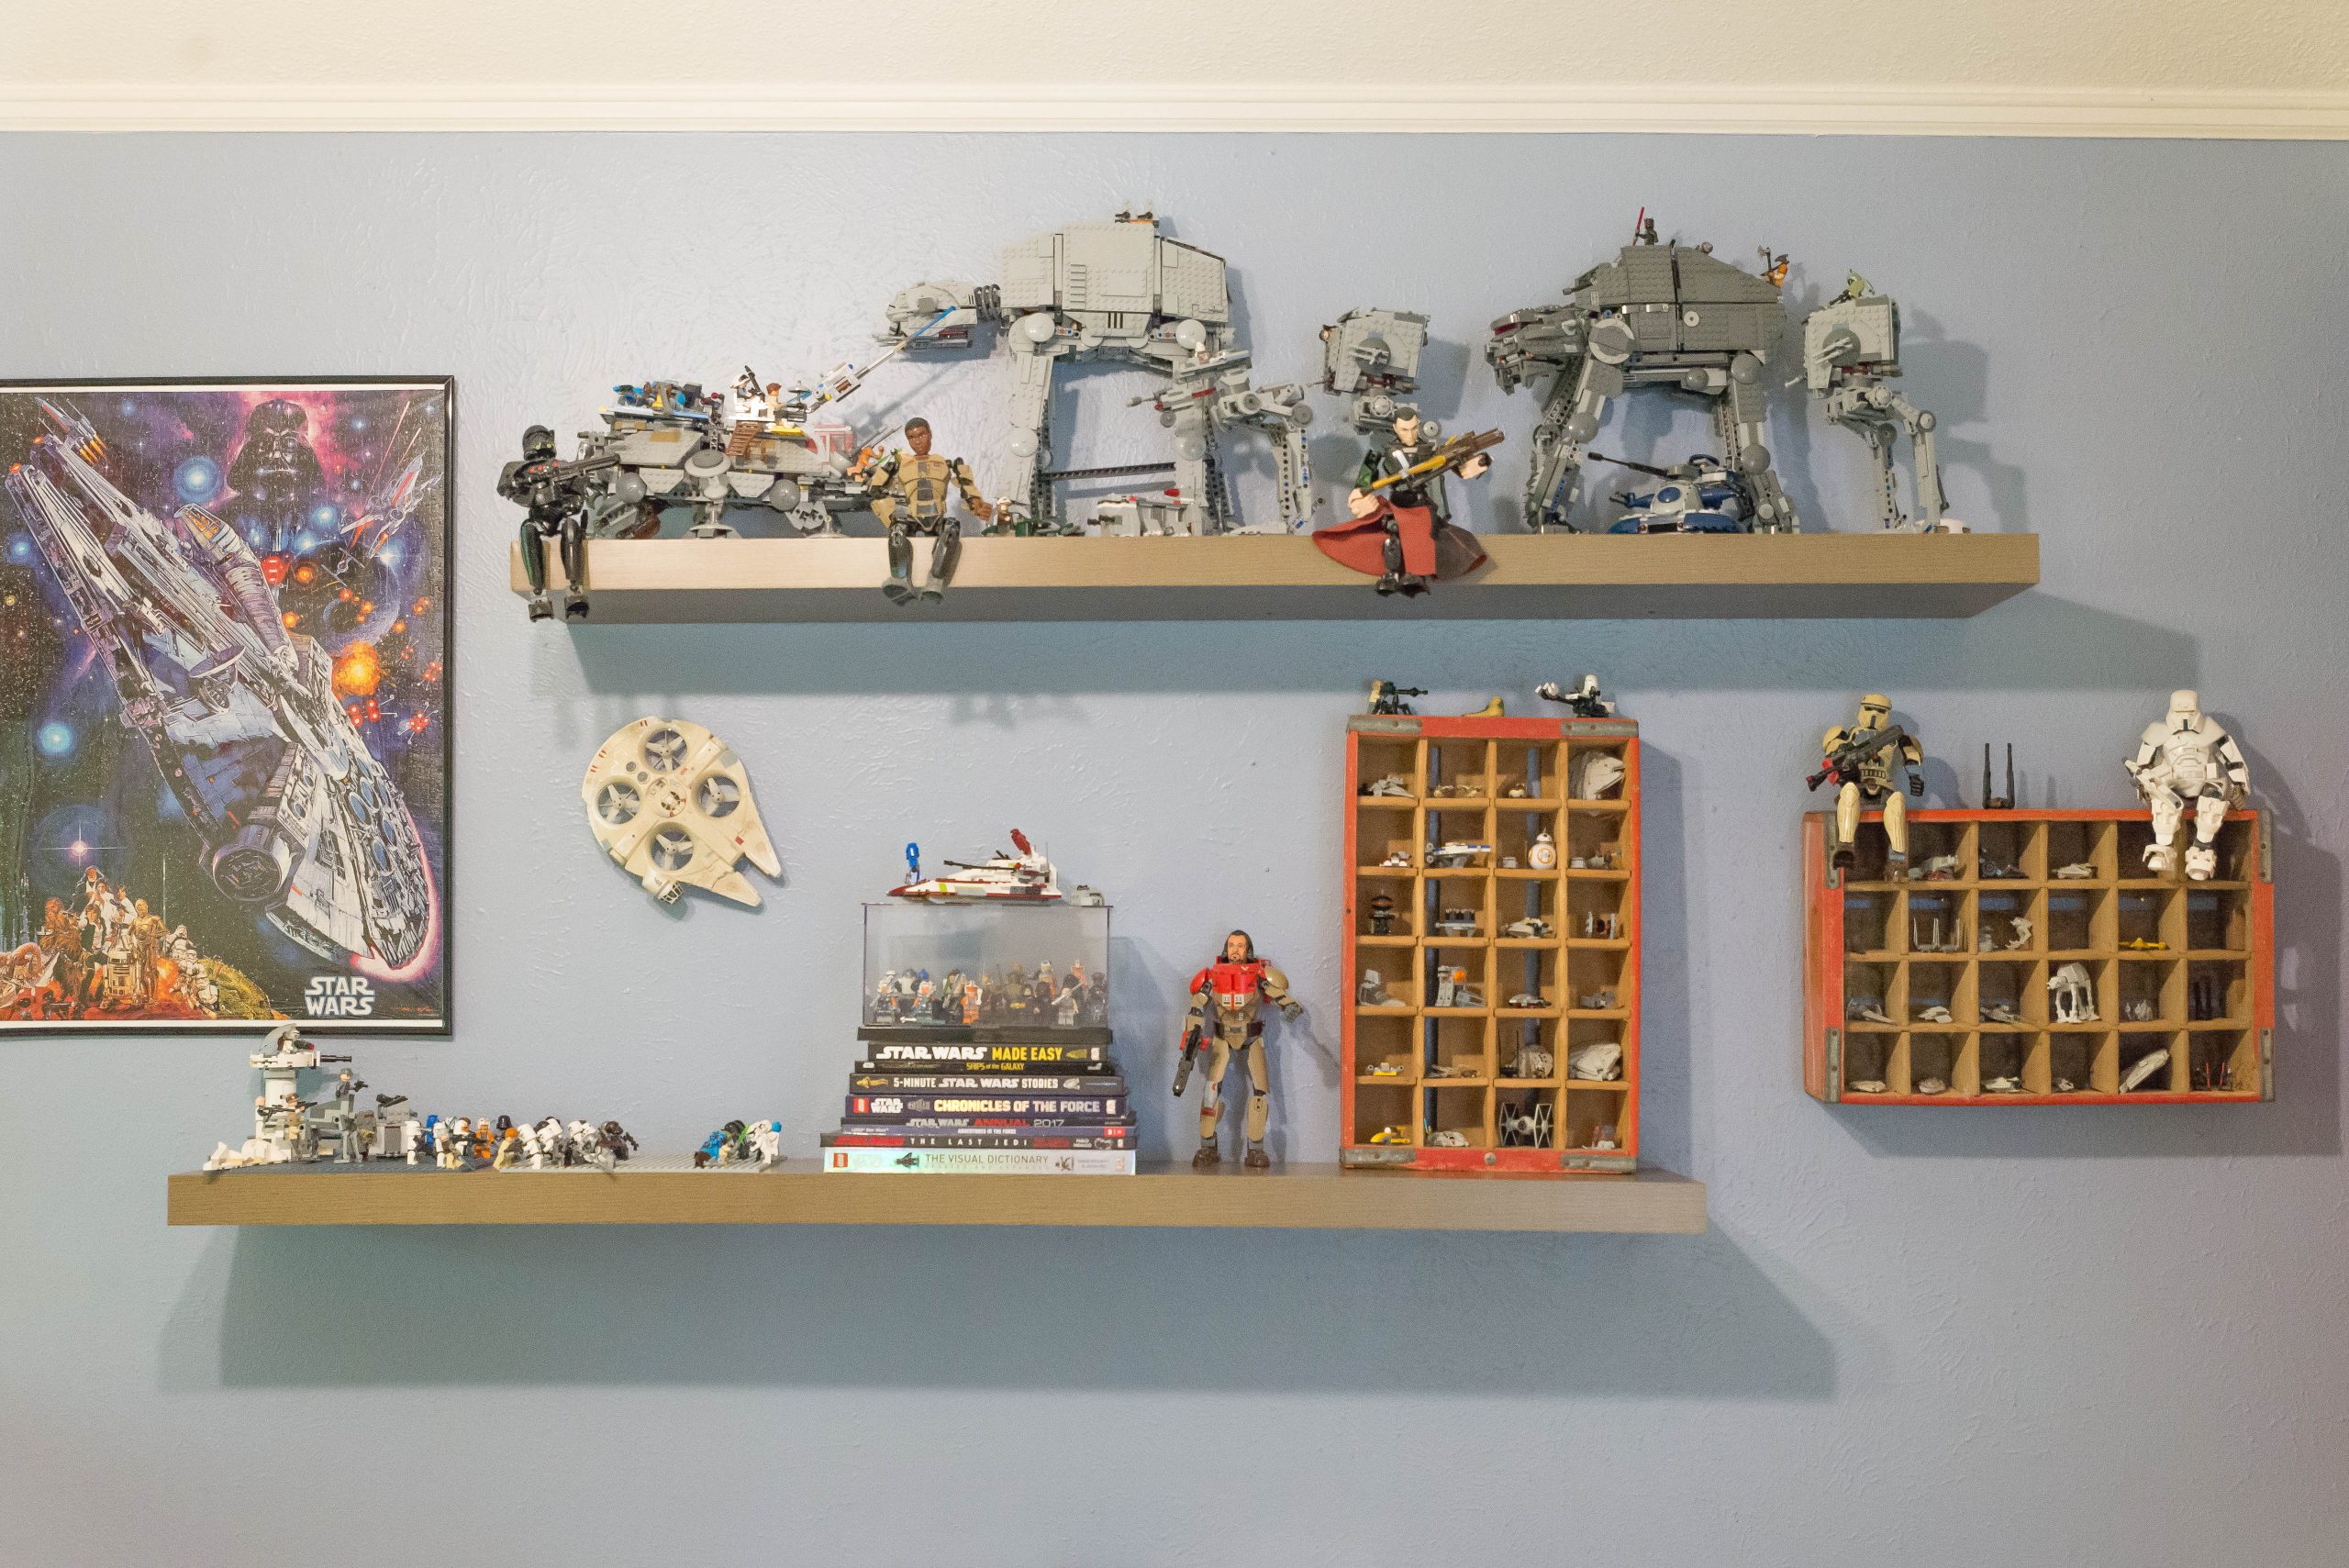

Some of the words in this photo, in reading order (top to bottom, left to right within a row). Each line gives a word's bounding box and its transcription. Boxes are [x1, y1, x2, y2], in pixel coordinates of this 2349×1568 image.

[305, 976, 375, 995] STAR
[305, 995, 375, 1016] WARS
[876, 1046, 932, 1060] STAR
[932, 1046, 987, 1060] WARS
[992, 1047, 1027, 1061] MADE
[1030, 1047, 1063, 1061] EASY
[966, 1062, 985, 1071] SHIPS
[1000, 1062, 1025, 1071] GALAXY
[894, 1077, 936, 1088] 5-MINUTE
[939, 1078, 978, 1088] STAR
[980, 1078, 1019, 1088] WARS
[1021, 1078, 1058, 1089] STORIES
[871, 1105, 903, 1113] WARS
[934, 1100, 1010, 1113] CHRONICLES
[1013, 1100, 1030, 1113] OF
[1033, 1100, 1056, 1113] THE
[1061, 1101, 1100, 1113] FORCE
[906, 1118, 941, 1129] STAR
[938, 1118, 970, 1127] WARS
[974, 1118, 1029, 1128] ANNUAL
[1033, 1118, 1064, 1128] 2017
[910, 1137, 935, 1145] THE
[948, 1138, 983, 1146] LAST
[925, 1153, 945, 1162] THE
[948, 1154, 984, 1163] VISUAL
[988, 1154, 1049, 1164] DICTIONARY
